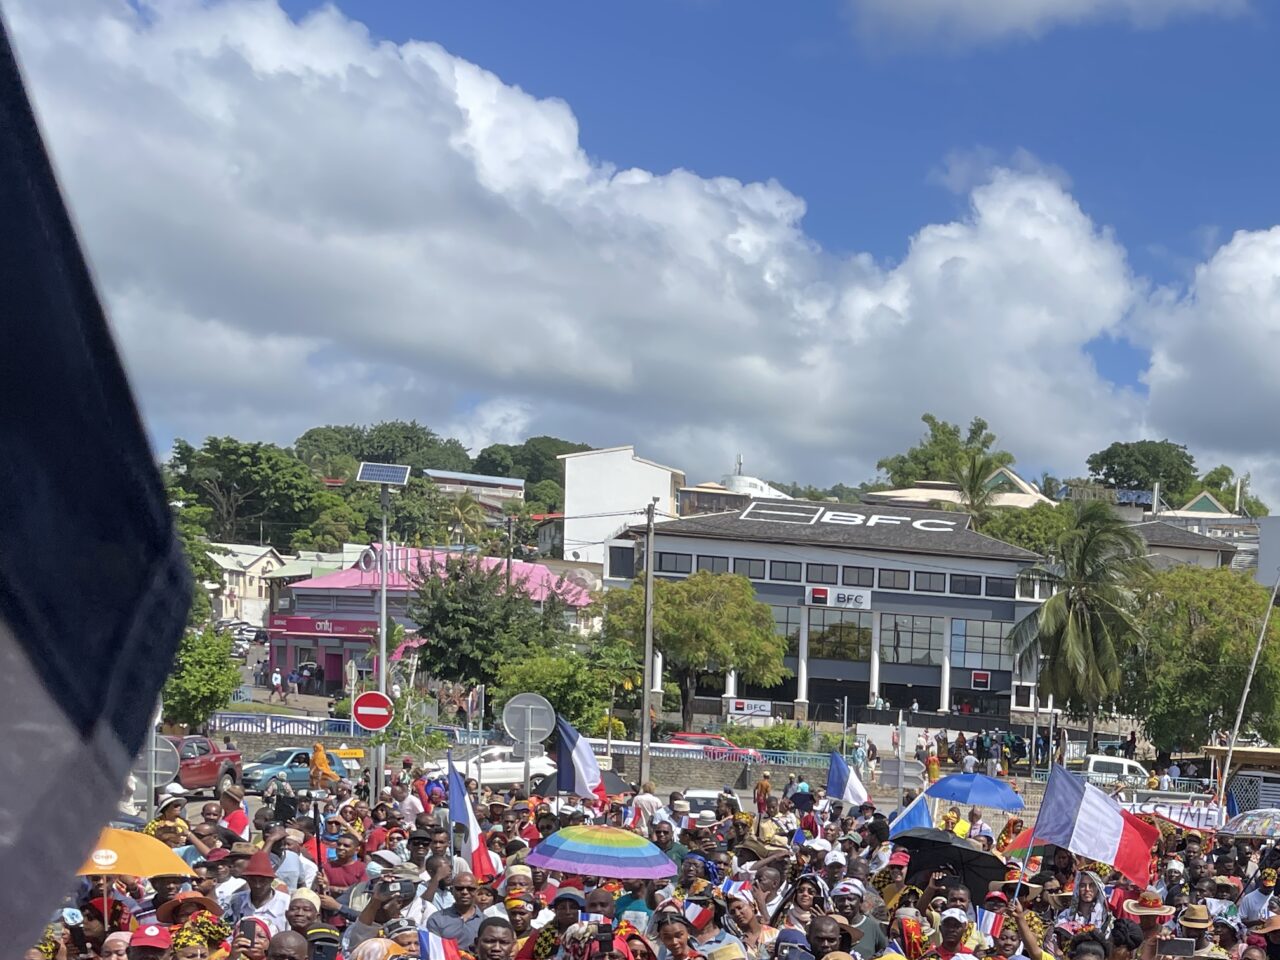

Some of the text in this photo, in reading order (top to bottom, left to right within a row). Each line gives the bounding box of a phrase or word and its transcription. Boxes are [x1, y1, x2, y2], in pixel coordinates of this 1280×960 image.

[820, 511, 957, 532] BFC
[837, 593, 864, 604] BFC
[315, 620, 332, 633] only
